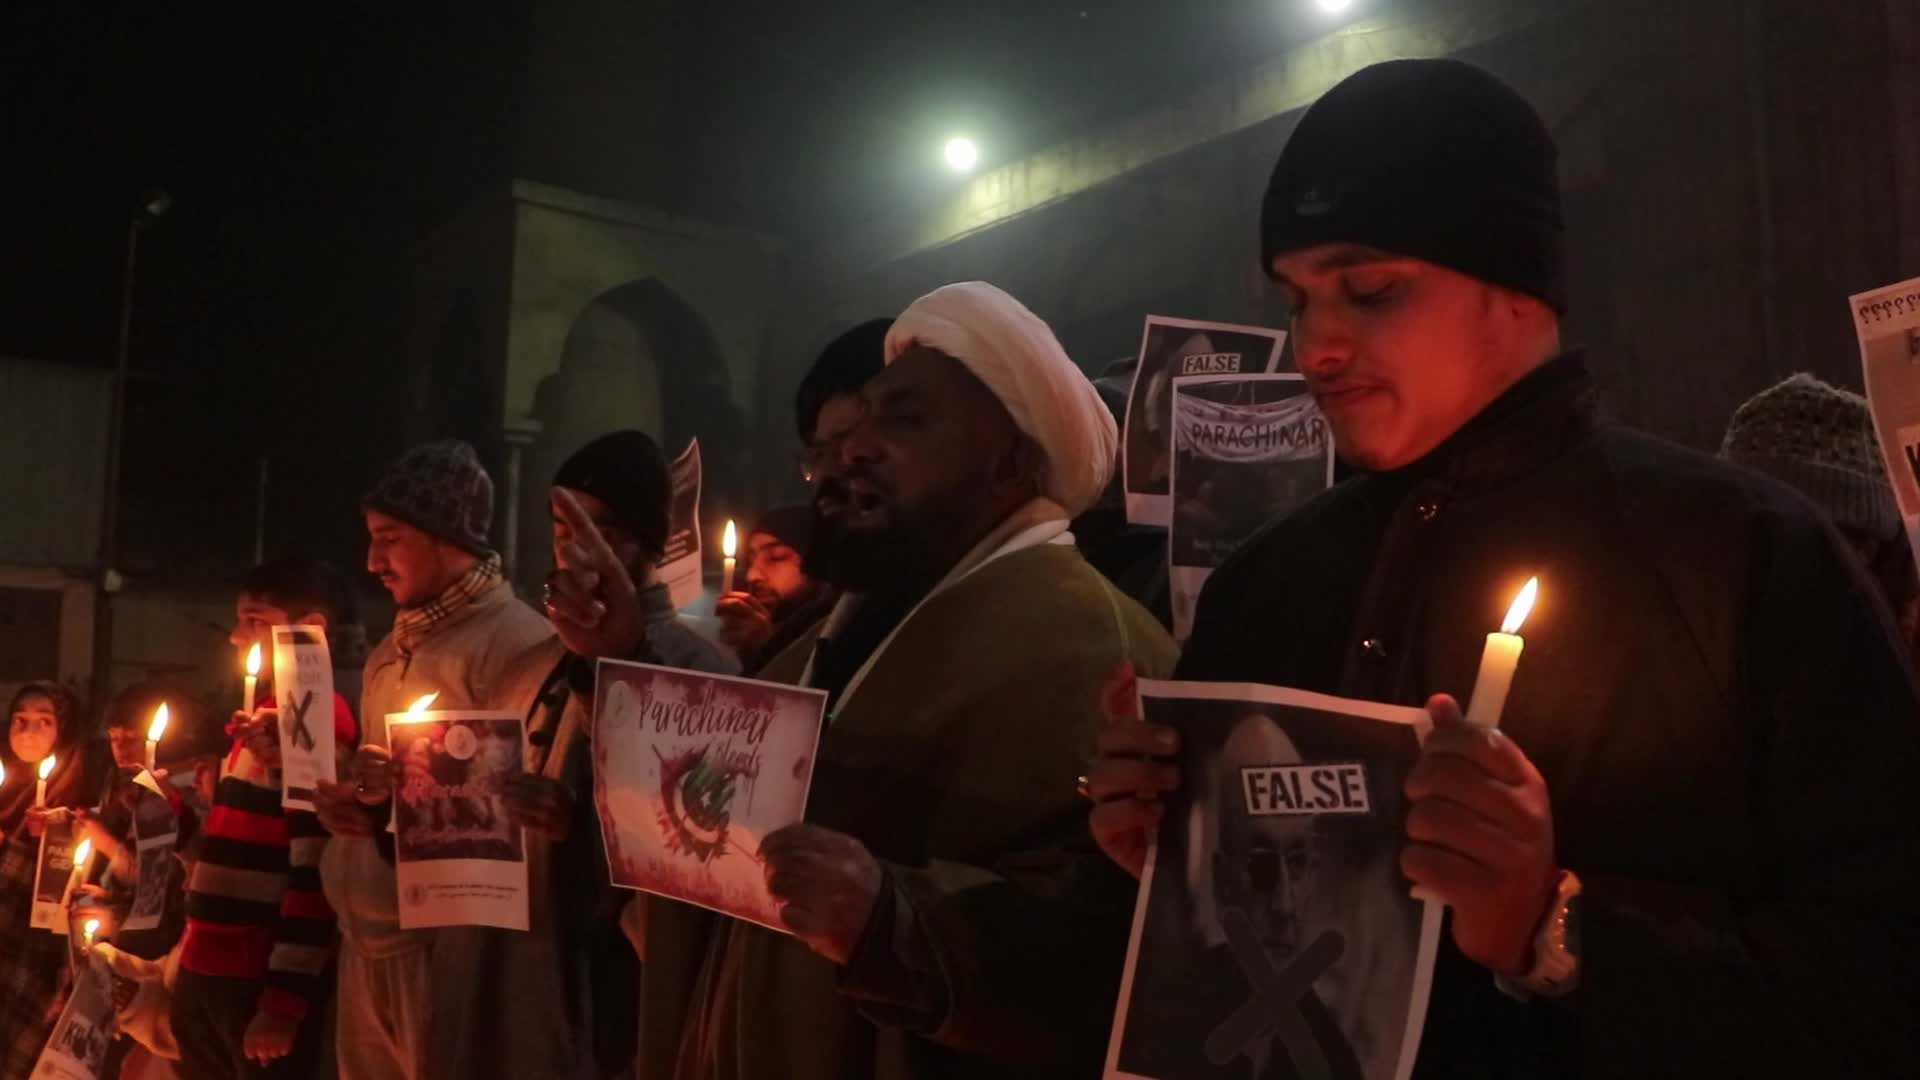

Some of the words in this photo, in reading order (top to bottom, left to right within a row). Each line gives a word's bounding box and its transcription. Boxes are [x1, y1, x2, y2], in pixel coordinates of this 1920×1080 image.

[1184, 355, 1239, 373] FALSE
[639, 684, 777, 745] Parachinar
[1246, 768, 1363, 810] FALSE
